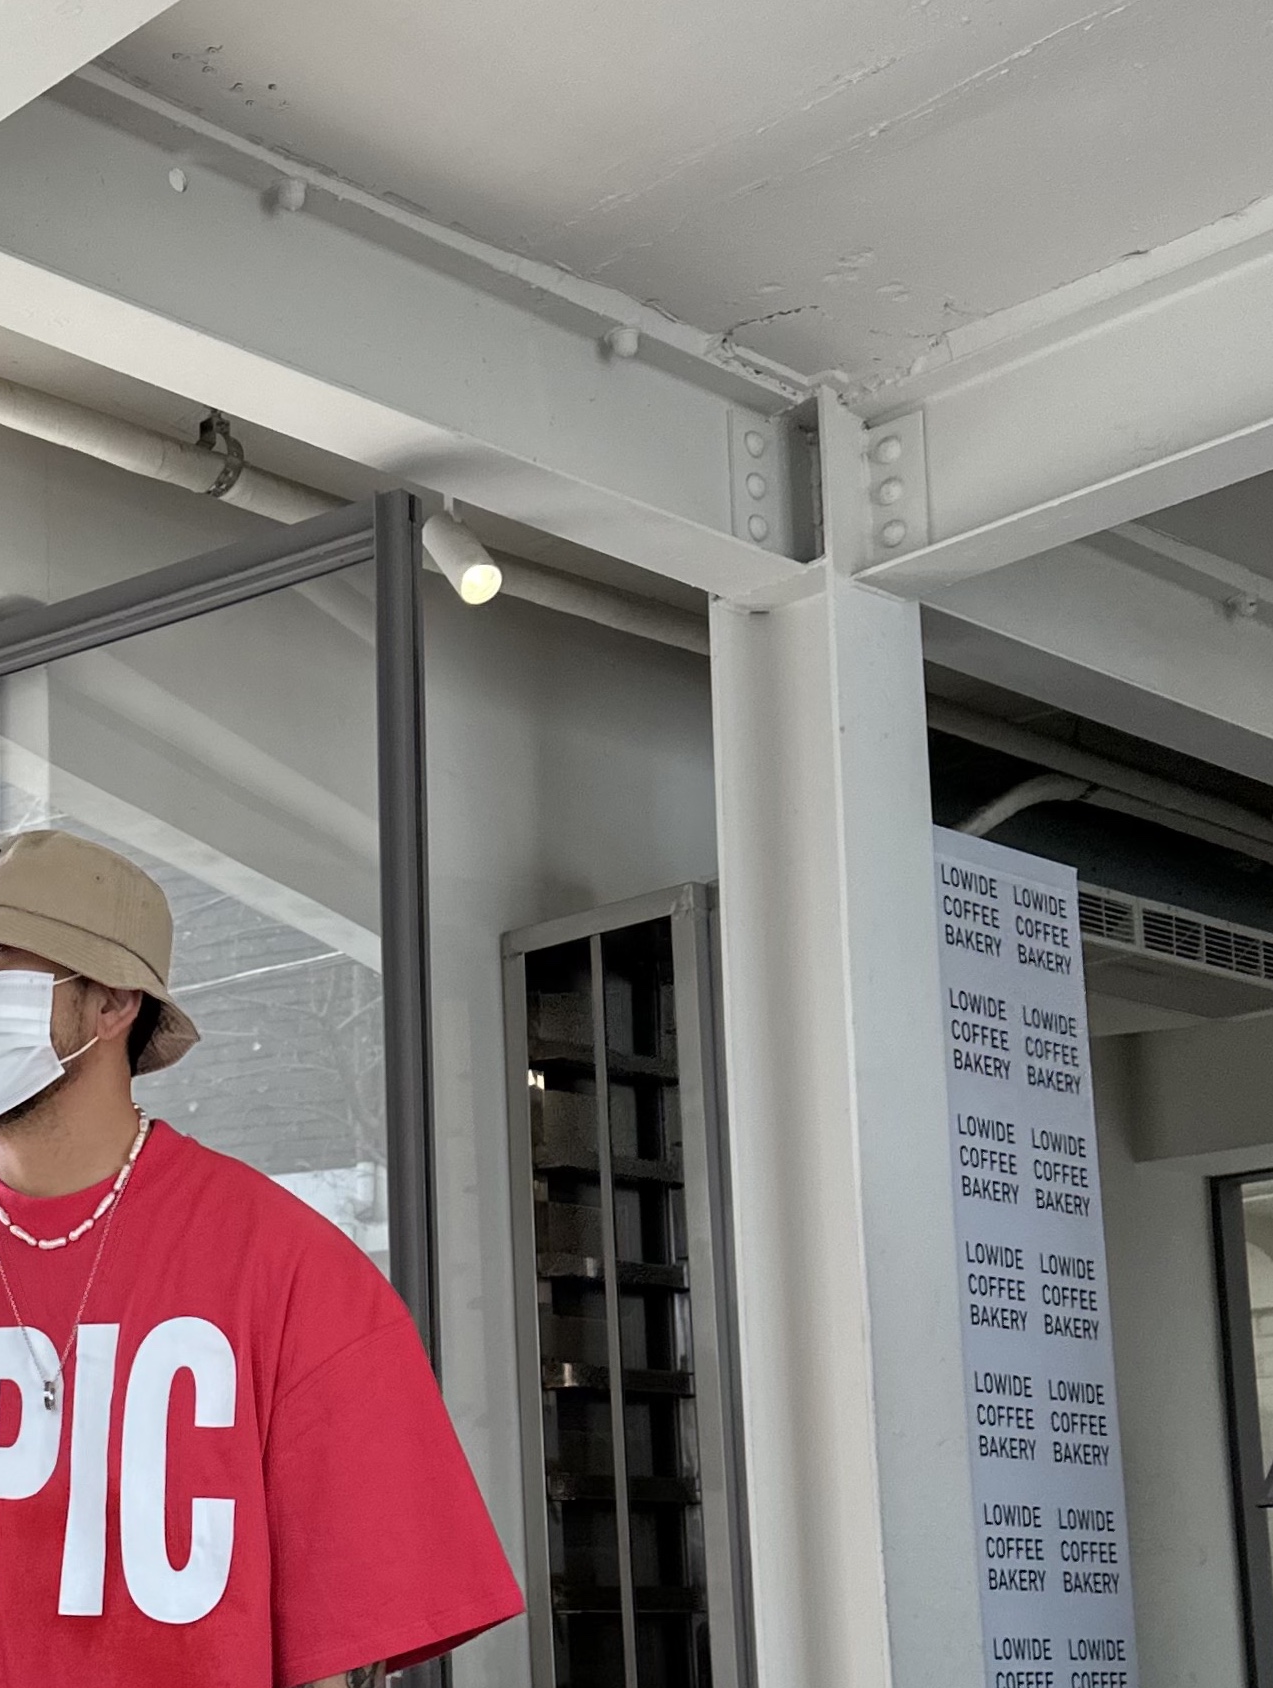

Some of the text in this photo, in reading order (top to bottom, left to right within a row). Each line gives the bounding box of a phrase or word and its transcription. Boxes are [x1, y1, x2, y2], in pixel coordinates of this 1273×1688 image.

[940, 863, 999, 900] LOWIDE
[942, 894, 1001, 930] COFFEE
[1012, 884, 1068, 920] LOWIDE
[944, 923, 1002, 958] BAKERY
[1014, 914, 1071, 949] COFFEE
[1016, 942, 1072, 976] BAKERY
[948, 987, 1008, 1022] LOWIDE
[950, 1018, 1011, 1053] COFFEE
[1022, 1005, 1078, 1039] LOWIDE
[952, 1047, 1012, 1081] BAKERY
[1024, 1035, 1080, 1069] COFFEE
[1026, 1063, 1082, 1096] BAKERY
[957, 1113, 1017, 1145] LOWIDE
[1031, 1127, 1087, 1159] LOWIDE
[958, 1144, 1018, 1176] COFFEE
[1032, 1158, 1090, 1189] COFFEE
[960, 1174, 1020, 1205] BAKERY
[1034, 1187, 1091, 1218] BAKERY
[965, 1240, 1025, 1271] LOWIDE
[1039, 1252, 1096, 1282] LOWIDE
[967, 1272, 1027, 1302] COFFEE
[1041, 1283, 1098, 1312] COFFEE
[969, 1303, 1028, 1332] BAKERY
[1043, 1313, 1100, 1341] BAKERY
[974, 1370, 1034, 1399] LOWIDE
[1047, 1379, 1106, 1406] LOWIDE
[976, 1403, 1036, 1431] COFFEE
[1049, 1410, 1109, 1437] COFFEE
[977, 1434, 1037, 1461] BAKERY
[1052, 1440, 1110, 1467] BAKERY
[983, 1502, 1043, 1529] LOWIDE
[1057, 1507, 1116, 1533] LOWIDE
[984, 1535, 1045, 1562] COFFEE
[1060, 1539, 1118, 1565] COFFEE
[987, 1567, 1047, 1592] BAKERY
[1062, 1570, 1120, 1595] BAKERY
[992, 1637, 1053, 1661] LOWIDE
[1067, 1638, 1127, 1662] LOWIDE
